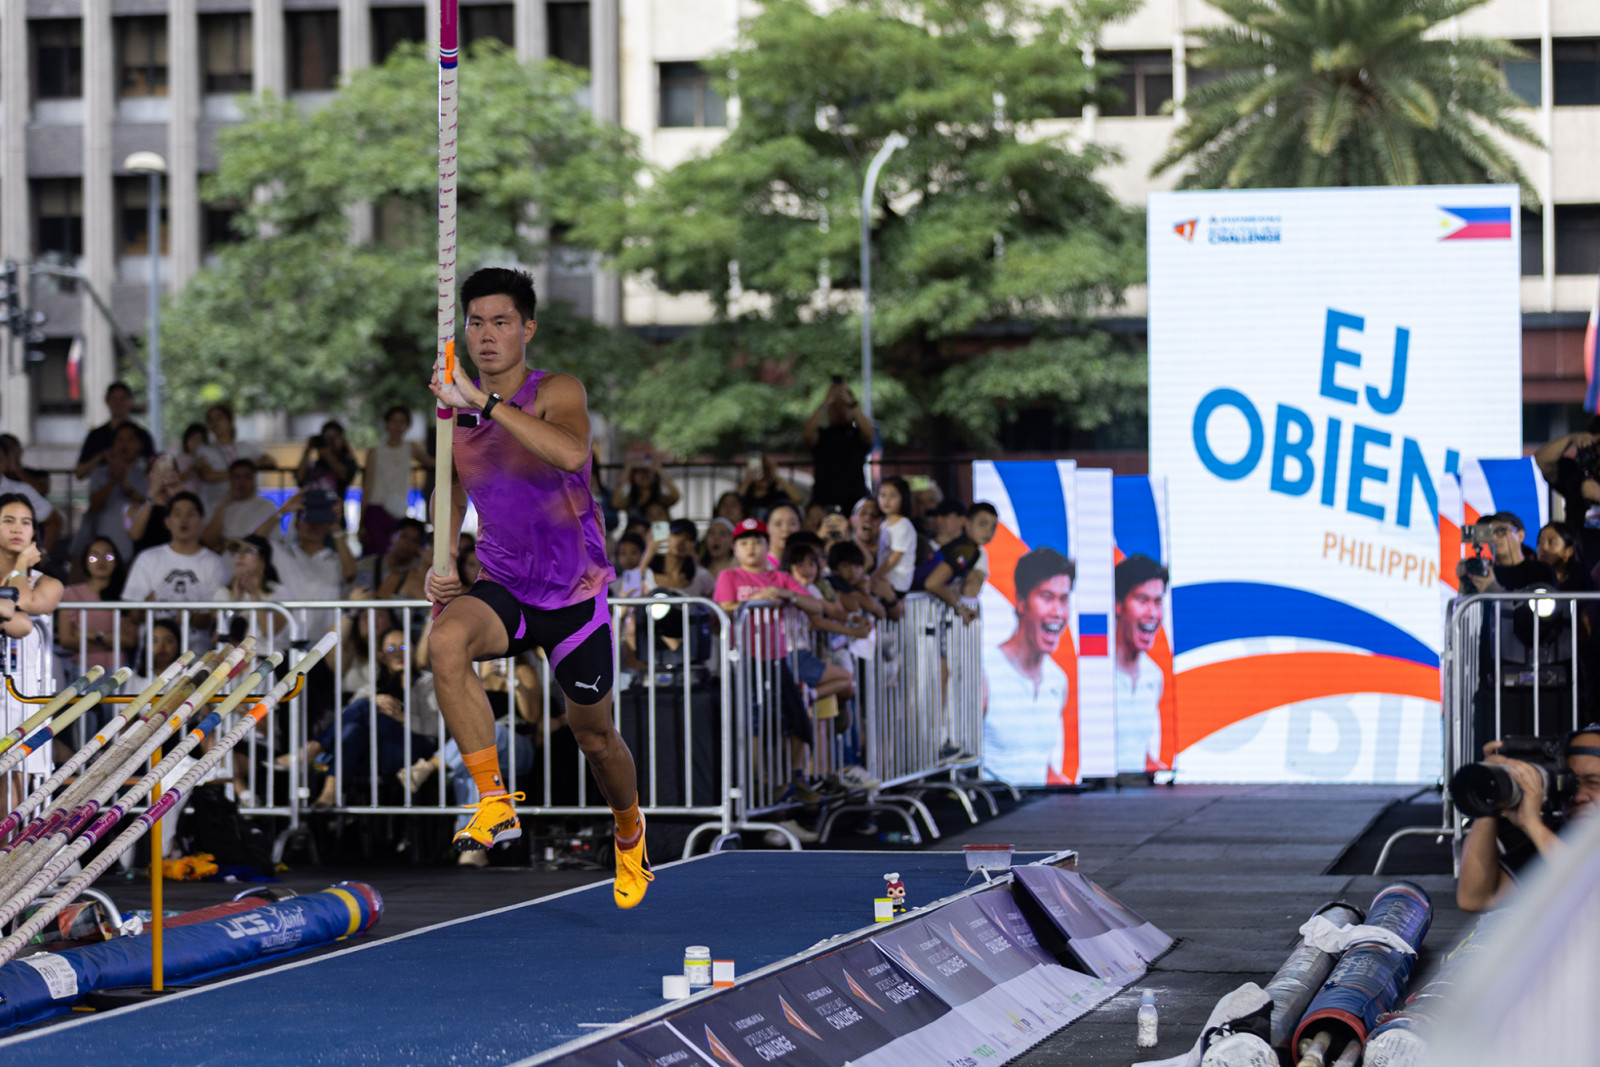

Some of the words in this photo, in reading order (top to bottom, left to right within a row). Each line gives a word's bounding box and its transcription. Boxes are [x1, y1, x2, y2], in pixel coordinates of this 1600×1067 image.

[1320, 307, 1410, 415] EJ
[1192, 386, 1460, 529] OBIEN
[487, 816, 516, 837] NITRO
[217, 913, 271, 939] UCS
[884, 981, 920, 1003] CHALLENGE
[825, 1006, 863, 1029] CHALLENGE
[754, 1034, 797, 1061] CHALLENGE
